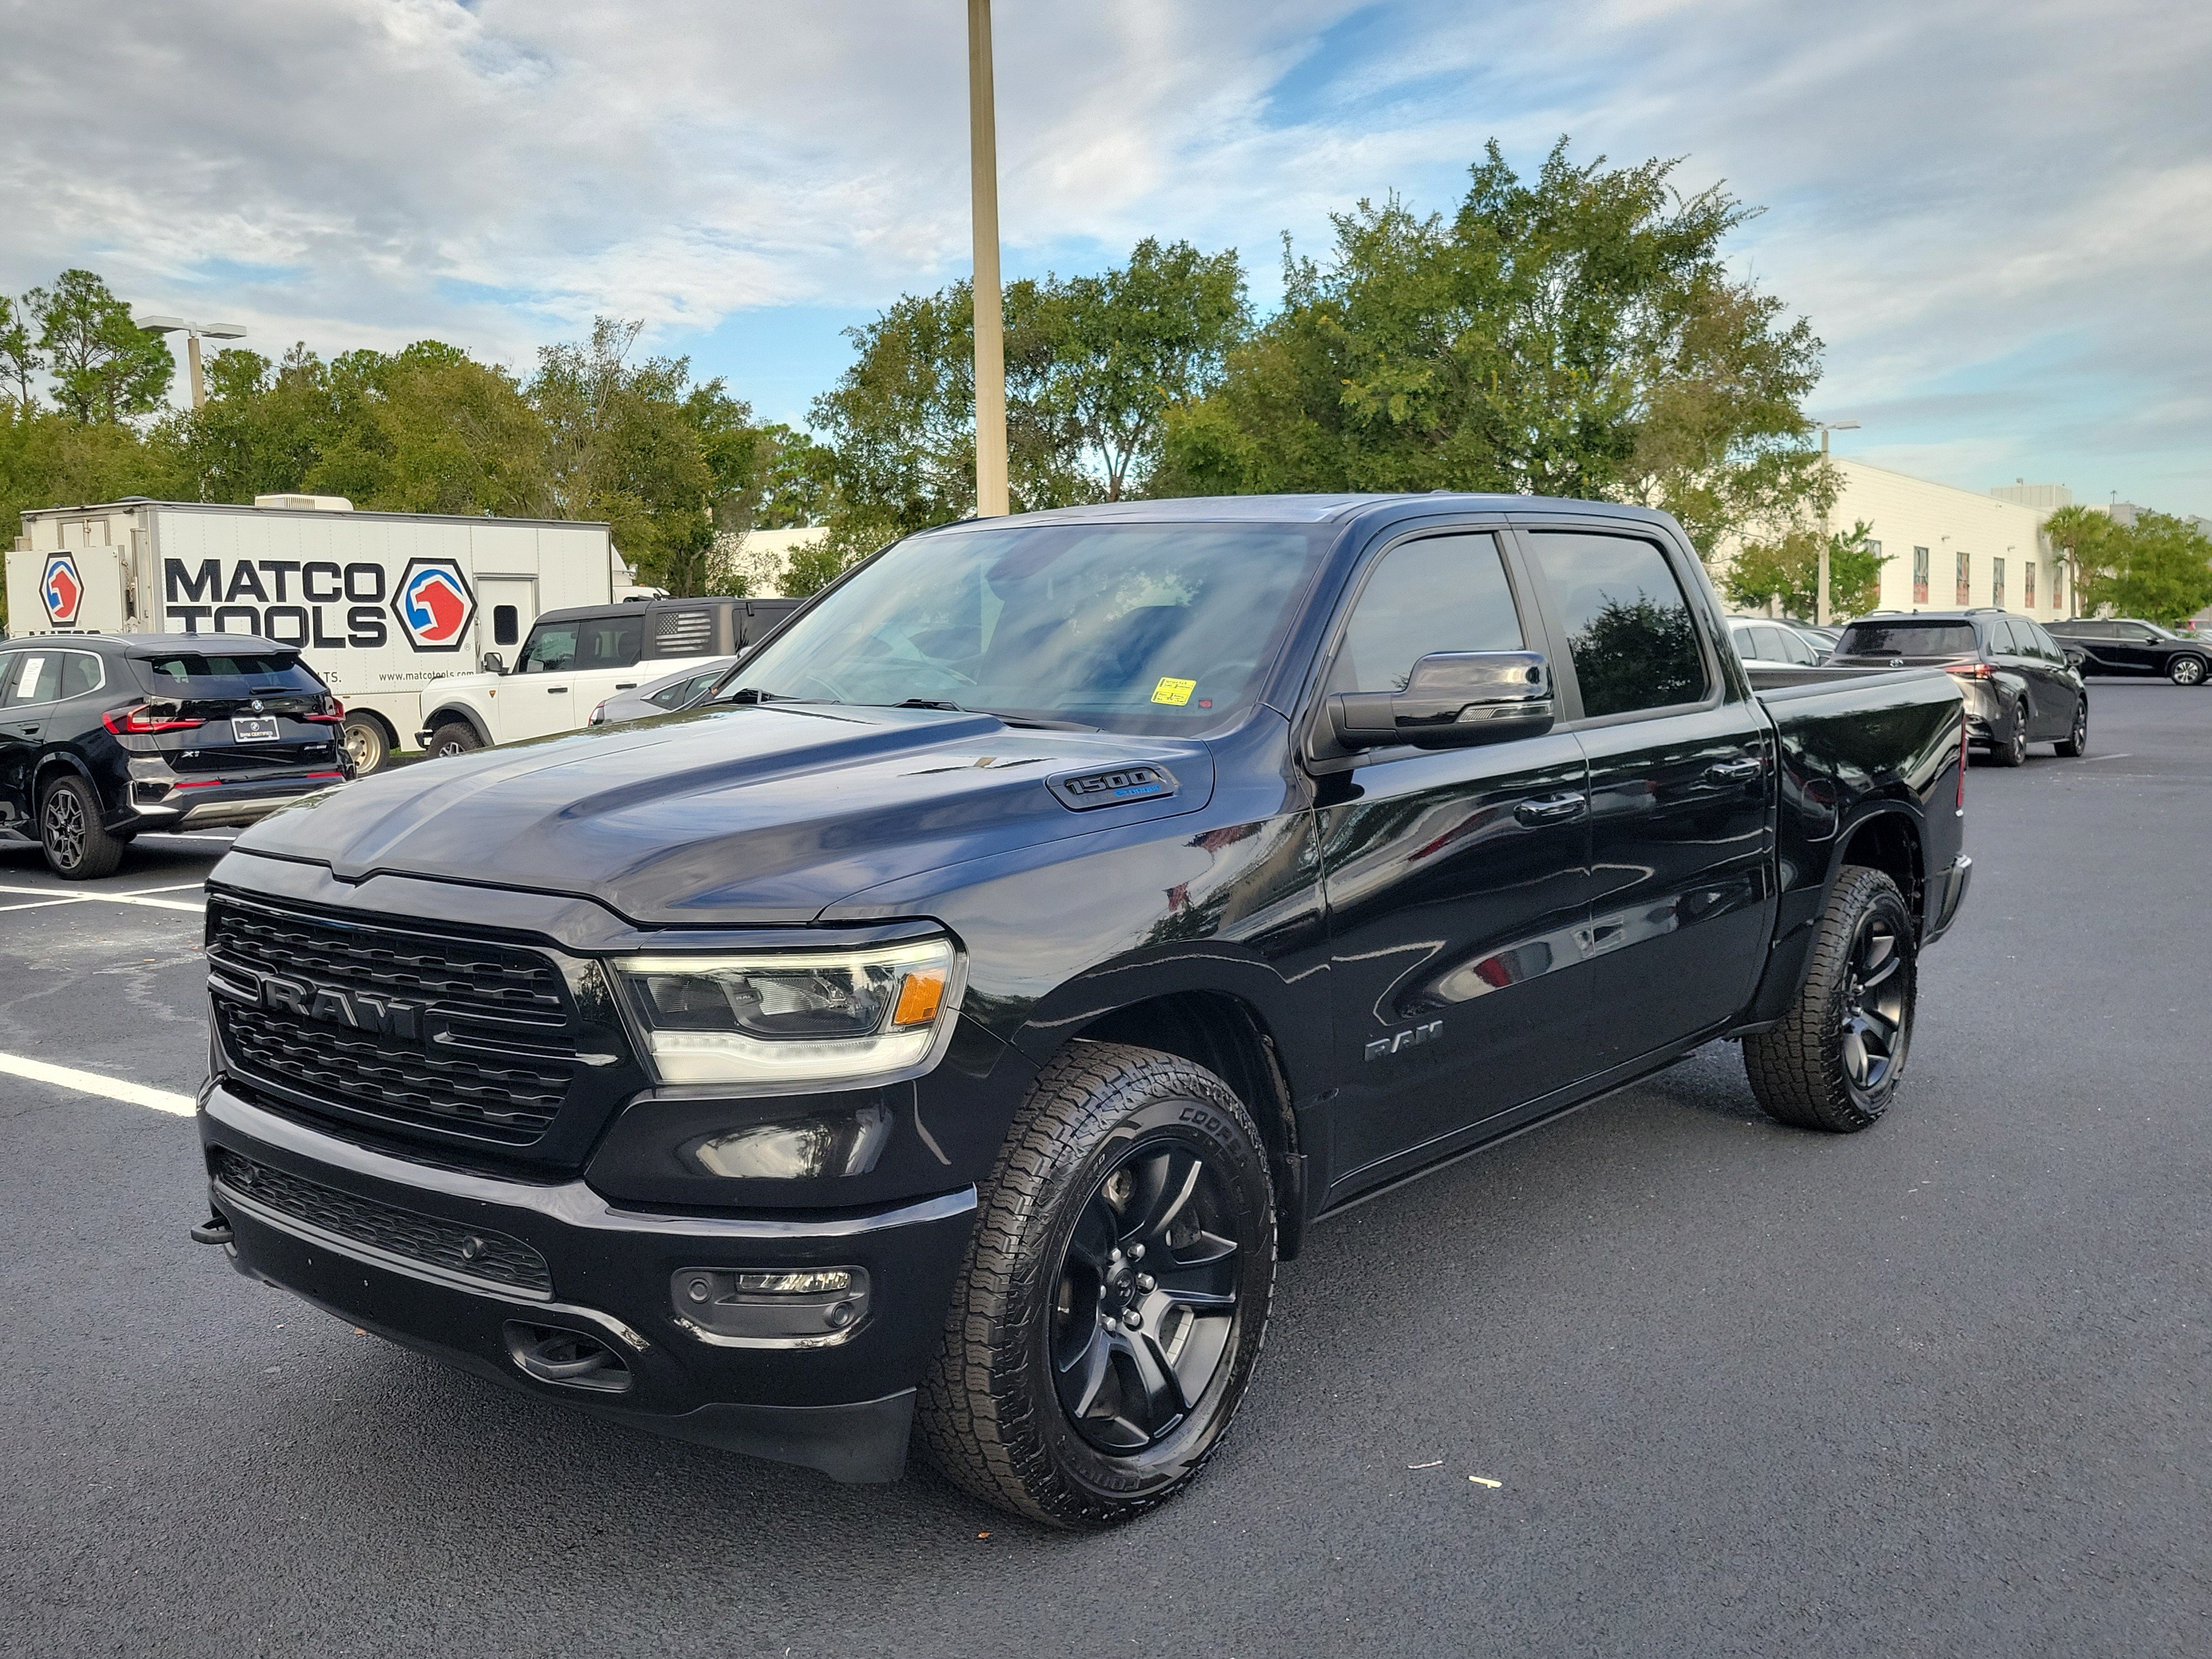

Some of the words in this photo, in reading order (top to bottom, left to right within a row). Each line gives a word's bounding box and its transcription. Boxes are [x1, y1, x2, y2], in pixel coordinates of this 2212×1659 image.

[165, 558, 385, 603] MATCO
[166, 605, 388, 648] TOOLS
[1066, 770, 1152, 795] 1500
[266, 975, 418, 1040] RAM
[1364, 1020, 1443, 1062] RAM
